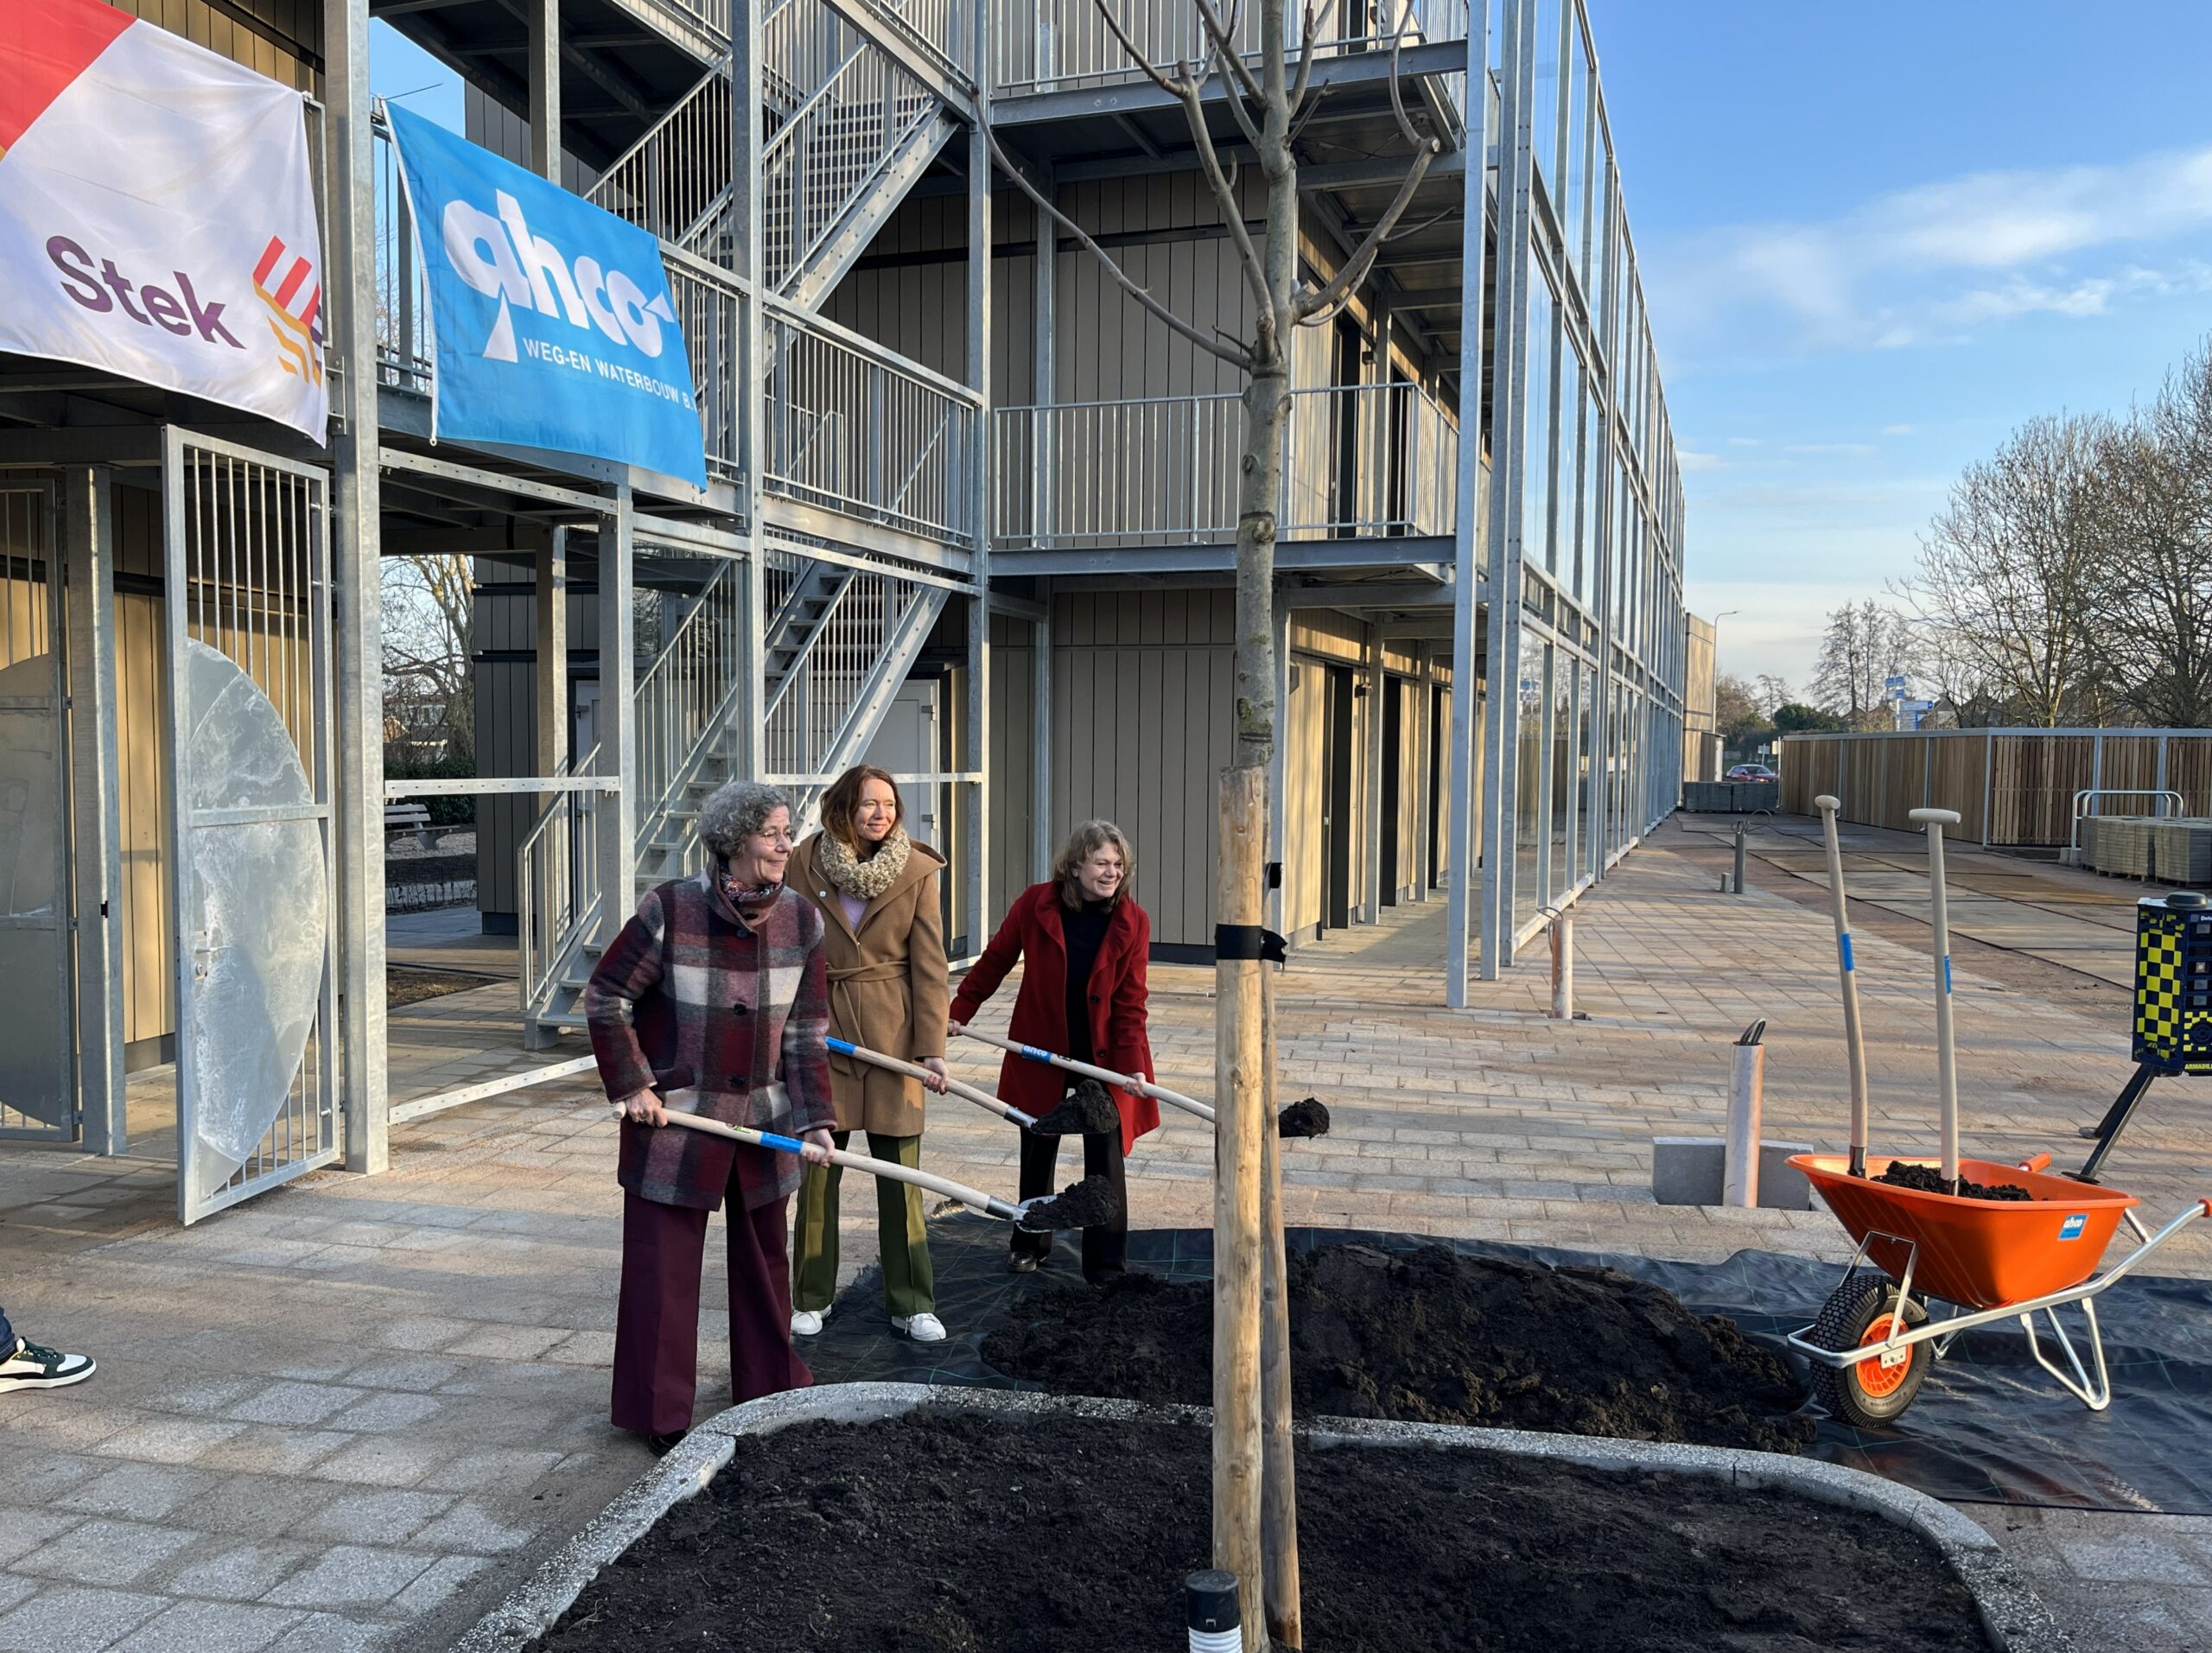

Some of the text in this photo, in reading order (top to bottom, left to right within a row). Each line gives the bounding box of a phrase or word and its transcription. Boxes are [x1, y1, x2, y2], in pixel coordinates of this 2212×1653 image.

[46, 235, 247, 349] Stek
[442, 188, 675, 364] ahco
[522, 337, 592, 373] WEG-EN
[594, 358, 679, 404] WATERBOUW
